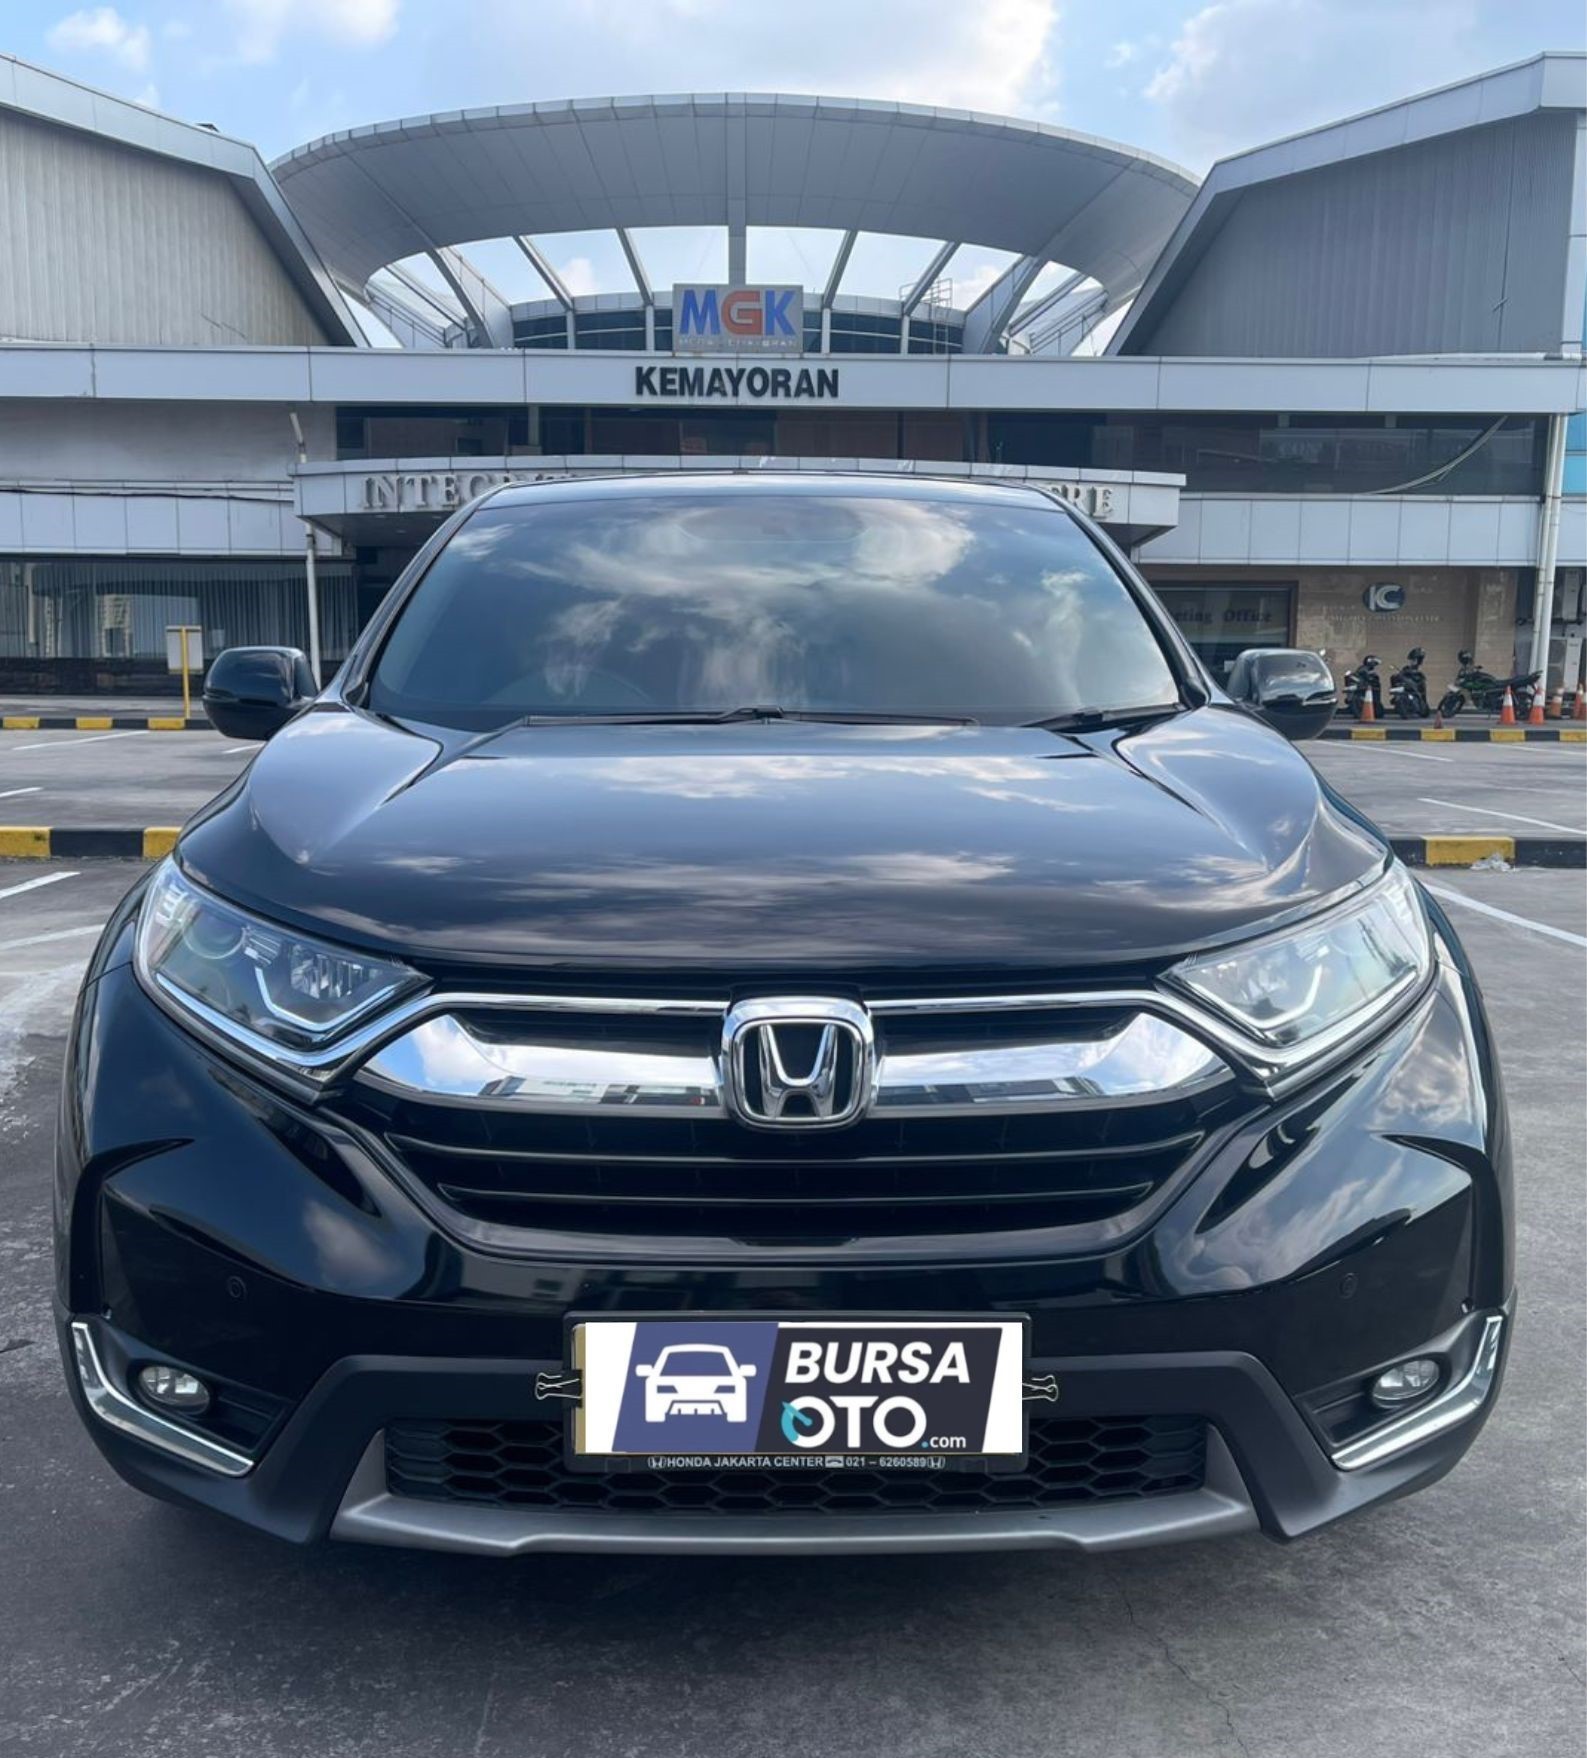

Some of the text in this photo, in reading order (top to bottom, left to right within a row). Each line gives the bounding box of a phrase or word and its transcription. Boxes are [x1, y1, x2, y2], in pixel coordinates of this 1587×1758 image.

[679, 289, 796, 336] MGK
[635, 366, 839, 398] KEMAYORAN
[667, 1456, 712, 1468] HONDA
[714, 1456, 771, 1468] JAKARTA
[774, 1456, 823, 1468] CENTER
[845, 1456, 866, 1468] 021
